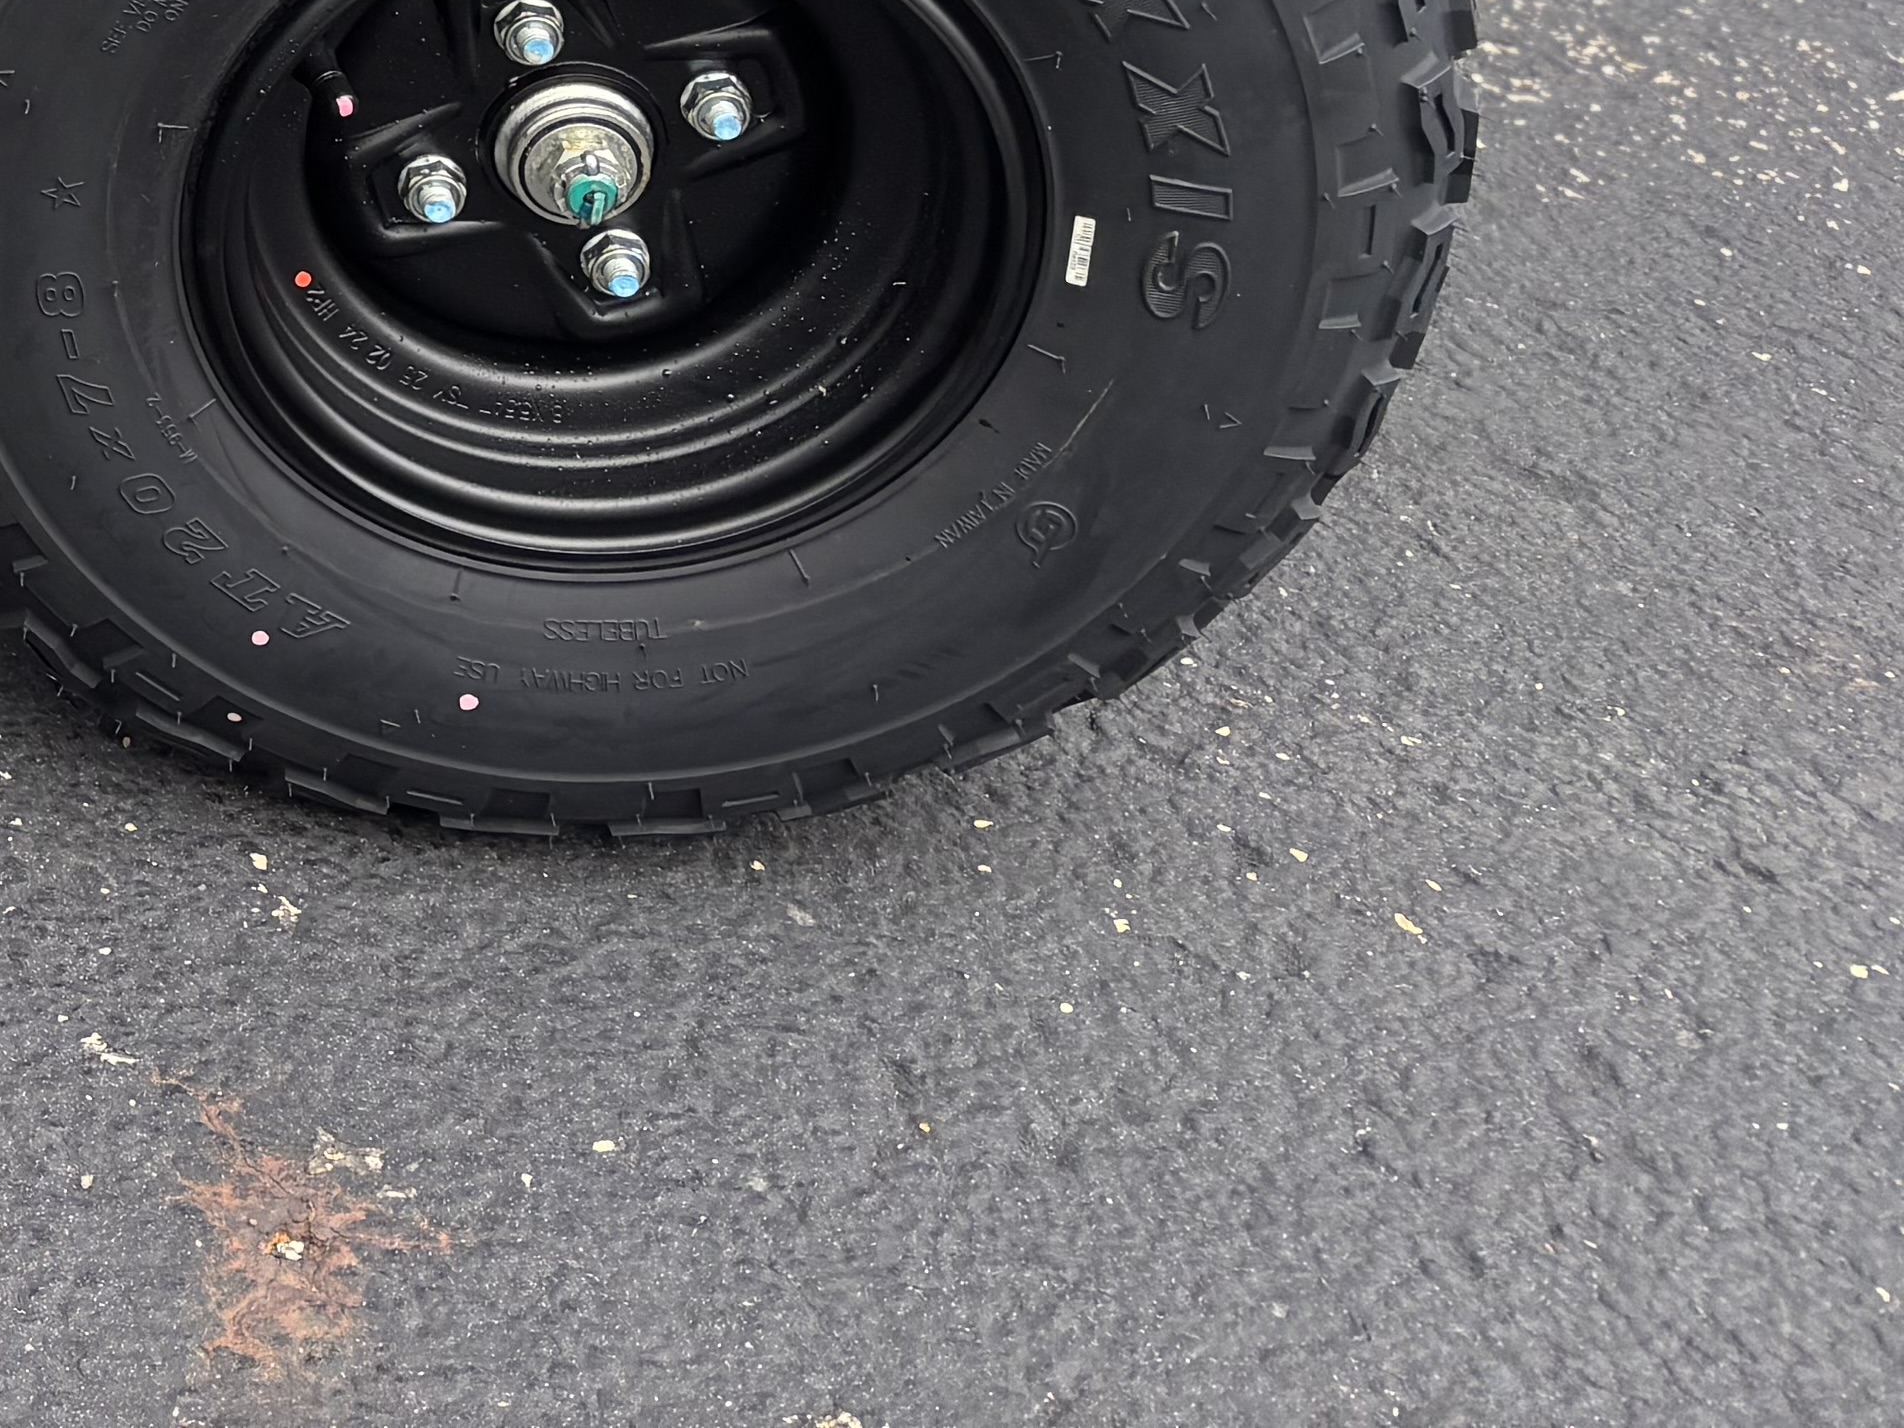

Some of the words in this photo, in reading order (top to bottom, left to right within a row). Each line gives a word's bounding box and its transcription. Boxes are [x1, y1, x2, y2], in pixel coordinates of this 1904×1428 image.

[134, 7, 160, 33] DO
[100, 20, 132, 54] SEE
[1010, 440, 1053, 480] MADE
[989, 479, 1016, 502] IN
[931, 494, 1002, 550] TAIWAN
[539, 614, 669, 643] TUBELESS
[450, 655, 500, 684] USE
[517, 664, 619, 694] HIGHWAY
[631, 667, 682, 691] FOR
[697, 657, 750, 686] NOT
